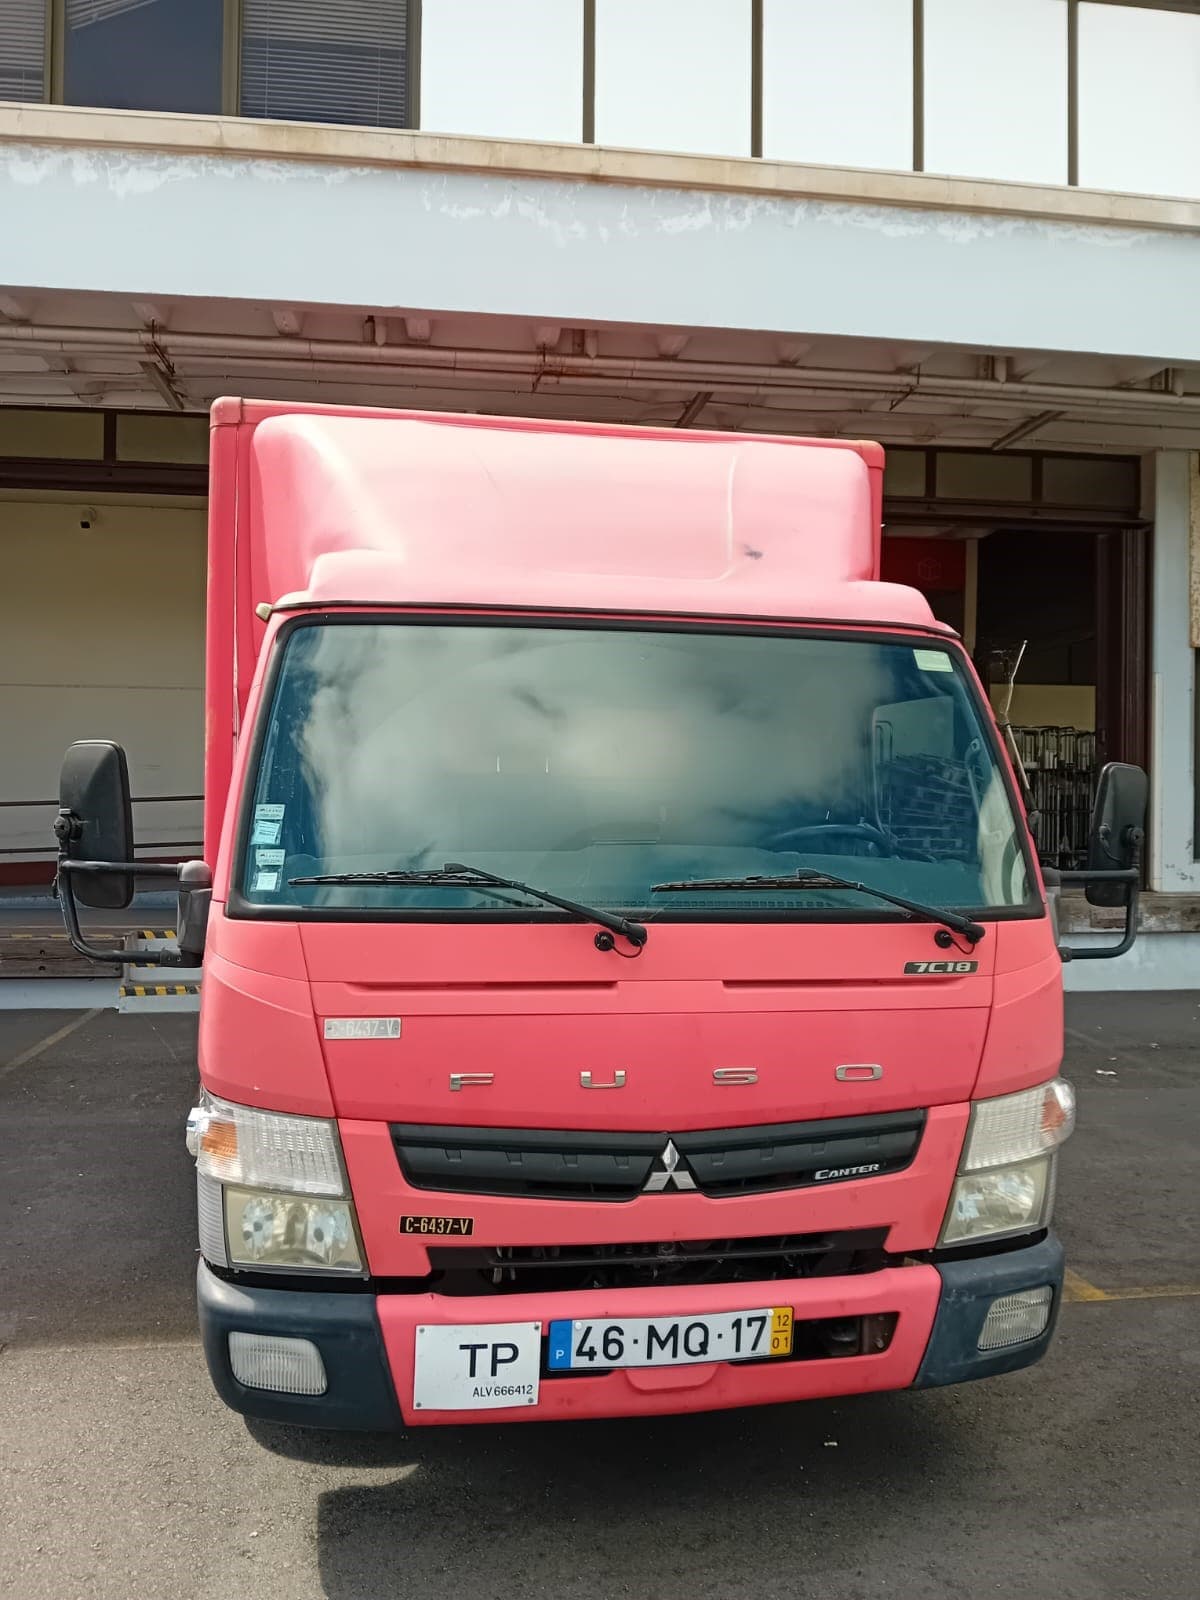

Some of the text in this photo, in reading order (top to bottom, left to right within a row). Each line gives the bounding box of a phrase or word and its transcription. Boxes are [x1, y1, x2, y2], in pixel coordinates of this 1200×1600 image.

[913, 962, 971, 973] 7C18
[449, 1063, 883, 1091] FUSO
[405, 1217, 469, 1234] C-6437-V
[776, 1314, 790, 1328] 12
[459, 1342, 520, 1378] TP
[555, 1350, 565, 1360] P
